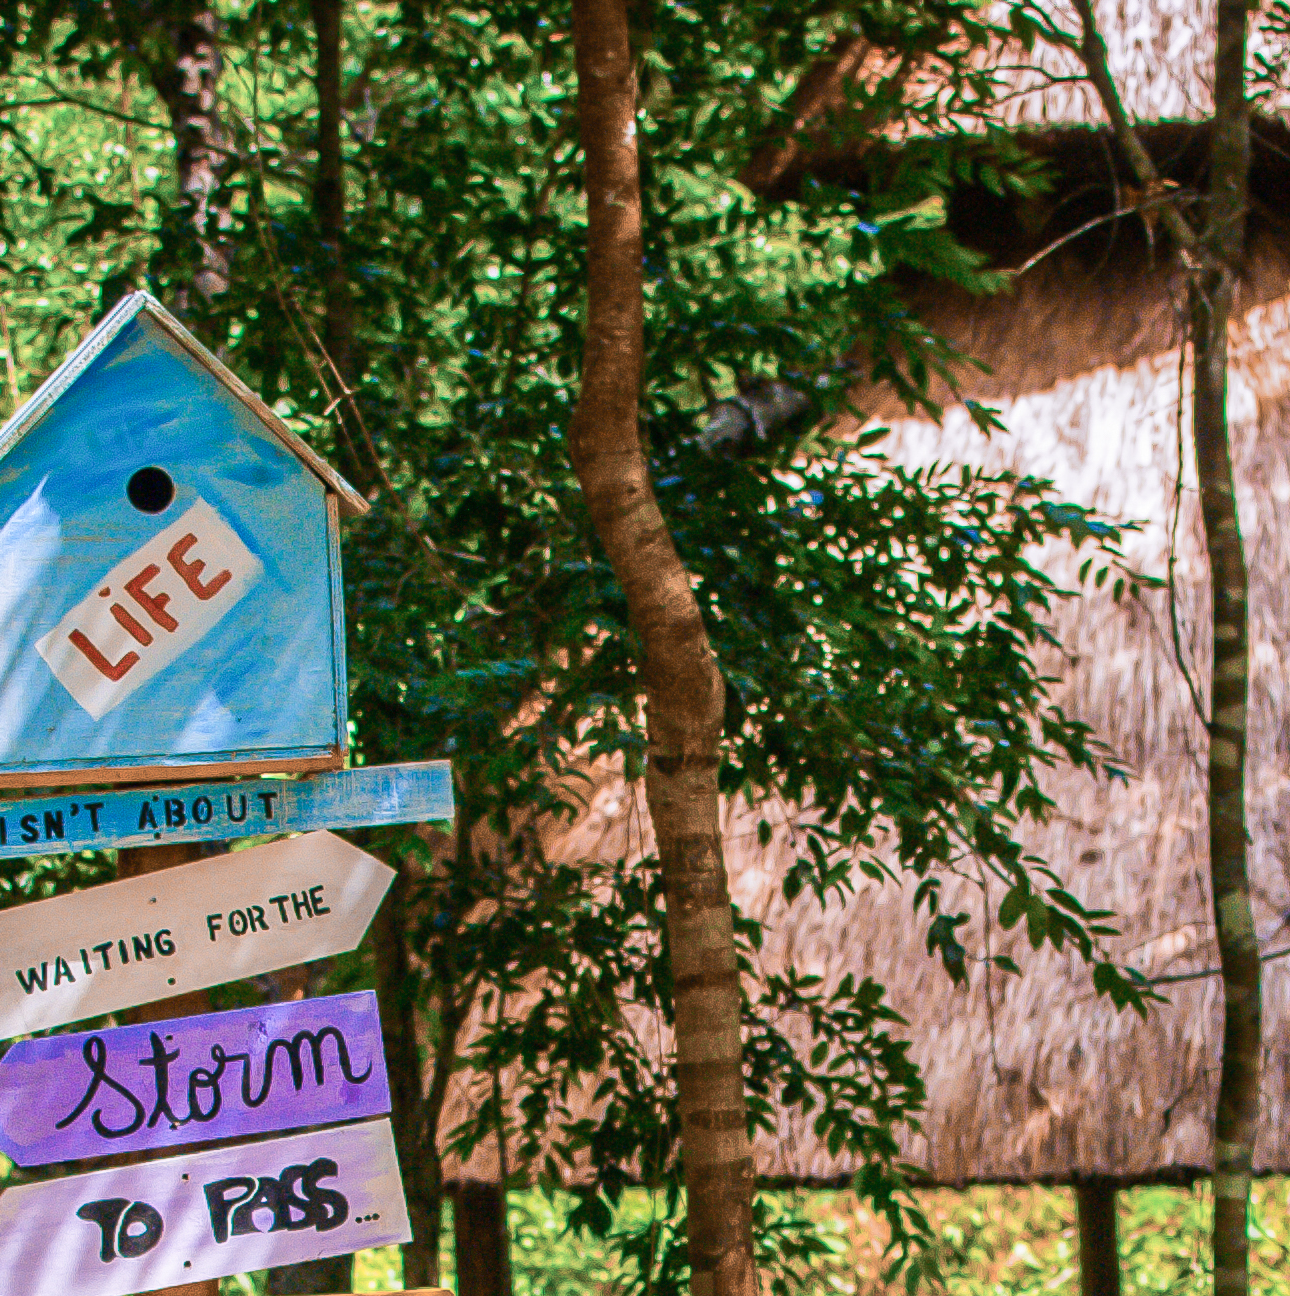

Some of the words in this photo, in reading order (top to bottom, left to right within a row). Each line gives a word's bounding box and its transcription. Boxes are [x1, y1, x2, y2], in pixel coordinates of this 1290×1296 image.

[138, 791, 278, 831] ABOUT
[15, 928, 177, 995] WAITING
[55, 1026, 373, 1138] Storm
[76, 1197, 164, 1263] TO
